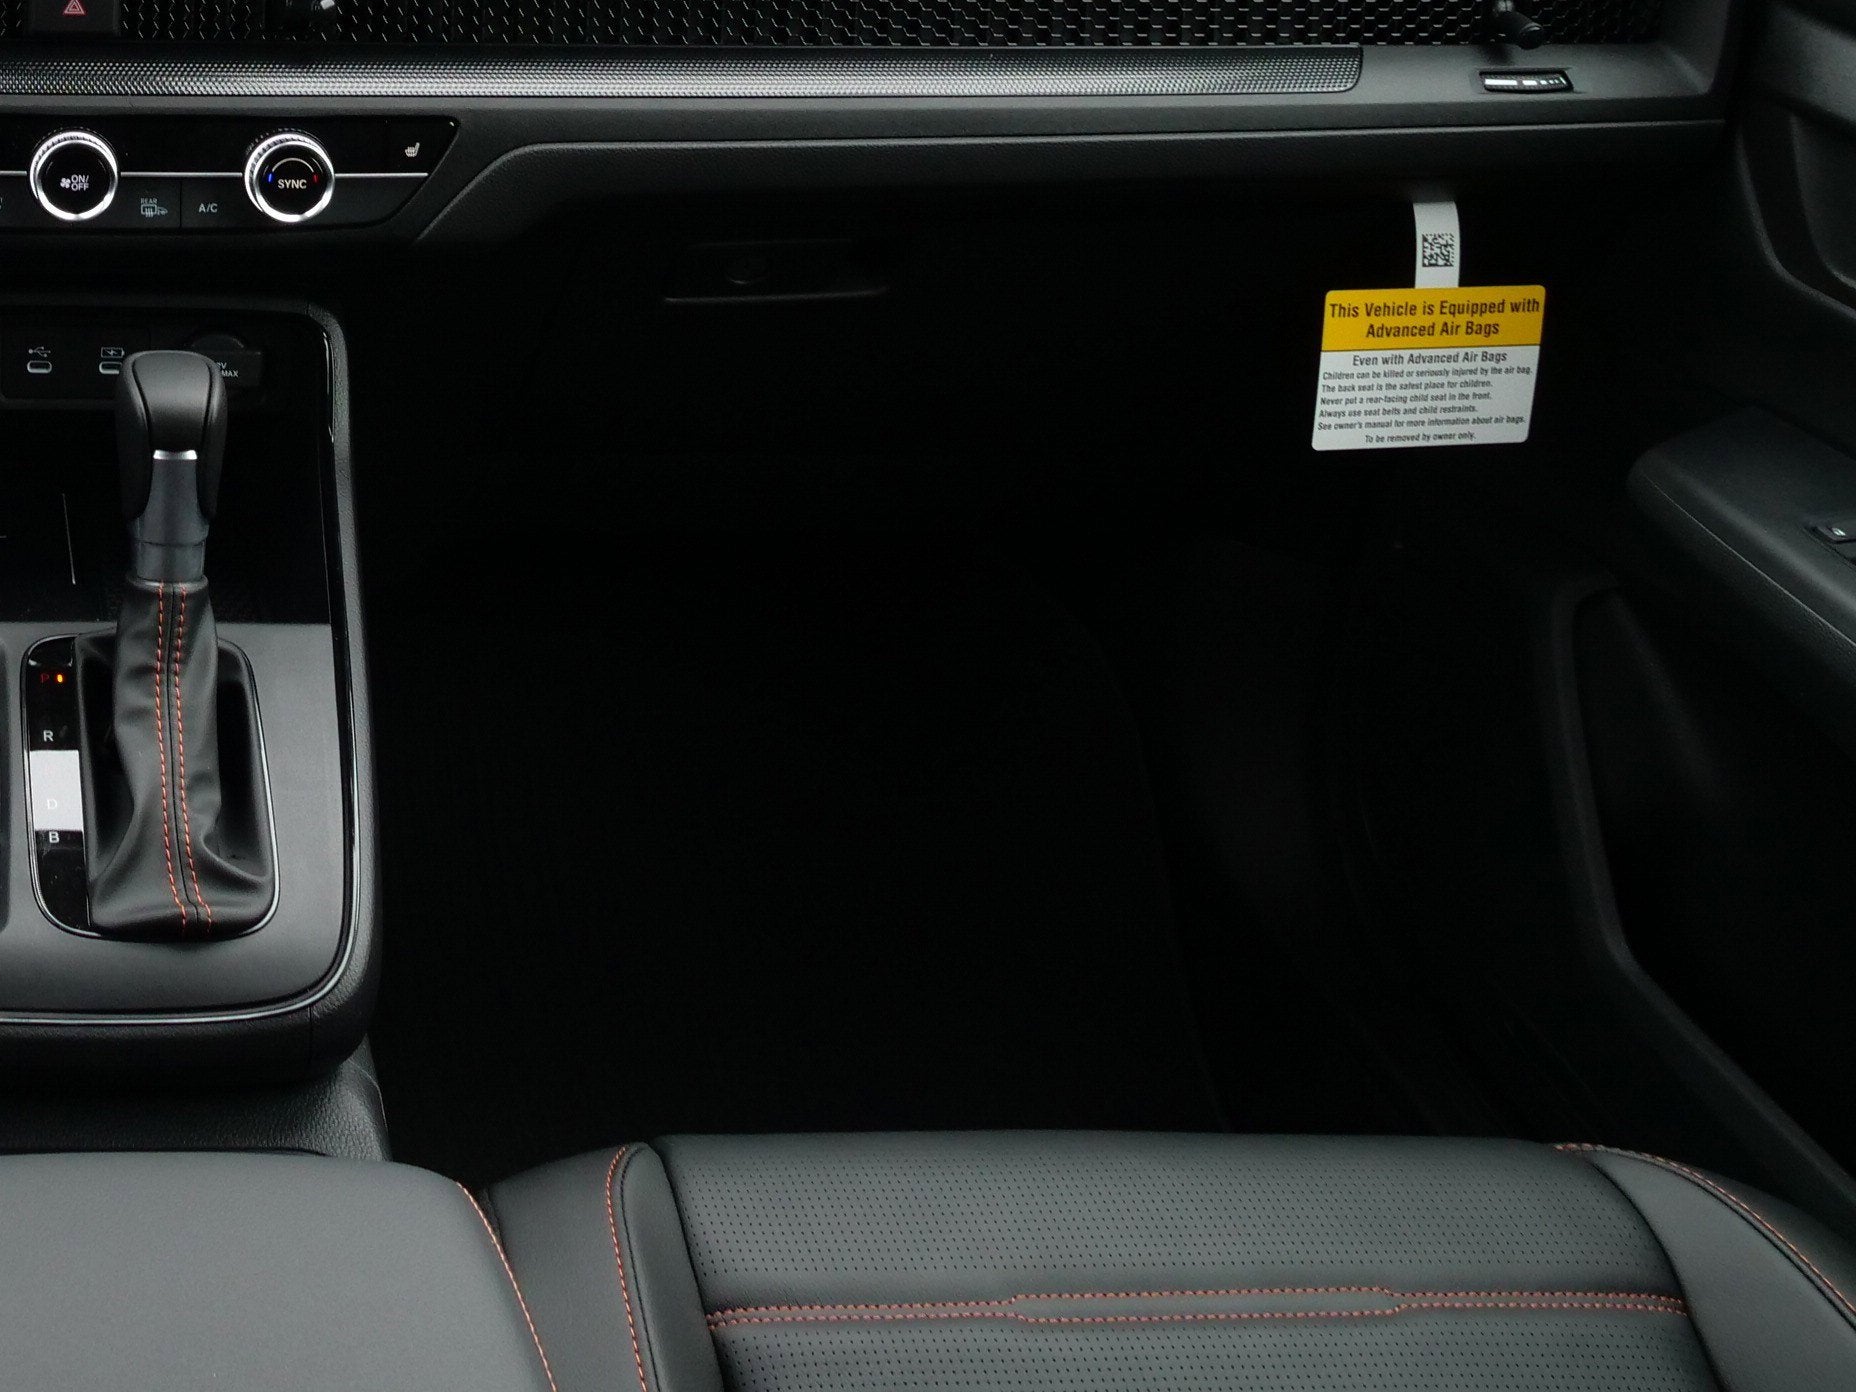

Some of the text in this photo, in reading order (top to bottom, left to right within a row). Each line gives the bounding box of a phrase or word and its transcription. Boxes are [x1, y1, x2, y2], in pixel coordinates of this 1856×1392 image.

[70, 174, 90, 184] ON/
[278, 178, 307, 190] SYNC
[70, 183, 90, 192] OFF
[198, 202, 218, 214] A/C
[1330, 298, 1540, 318] This Vehicle is Equipped with
[1366, 321, 1500, 338] Advanced Air Bags
[1352, 351, 1508, 366] Even with Advanced Air Bags
[1323, 371, 1355, 380] Children
[1383, 370, 1404, 378] killed
[1416, 369, 1450, 378] seriously
[1452, 368, 1478, 377] injured
[1480, 368, 1489, 376] by
[1490, 366, 1502, 374] the
[1322, 384, 1336, 392] The
[1338, 384, 1356, 392] back
[1376, 382, 1383, 390] is
[1385, 382, 1397, 390] the
[1399, 382, 1422, 390] safest
[1424, 381, 1445, 390] place
[1447, 380, 1458, 388] for
[1460, 380, 1494, 388] children.
[1320, 397, 1343, 406] Never
[1344, 396, 1358, 406] put
[1410, 394, 1428, 402] child
[1458, 392, 1470, 400] the
[1319, 410, 1346, 418] Always
[1364, 408, 1380, 416] seat
[1418, 406, 1438, 414] child
[1318, 422, 1332, 430] See
[1364, 420, 1392, 428] manual
[1406, 419, 1426, 427] more
[1428, 418, 1470, 426] information
[1471, 416, 1492, 424] about
[1494, 416, 1504, 424] air
[1365, 434, 1374, 443] To
[1376, 434, 1384, 442] be
[1386, 434, 1420, 442] removed
[1422, 433, 1430, 442] by
[1458, 430, 1476, 441] only.
[43, 730, 54, 742] R
[48, 831, 60, 844] B
